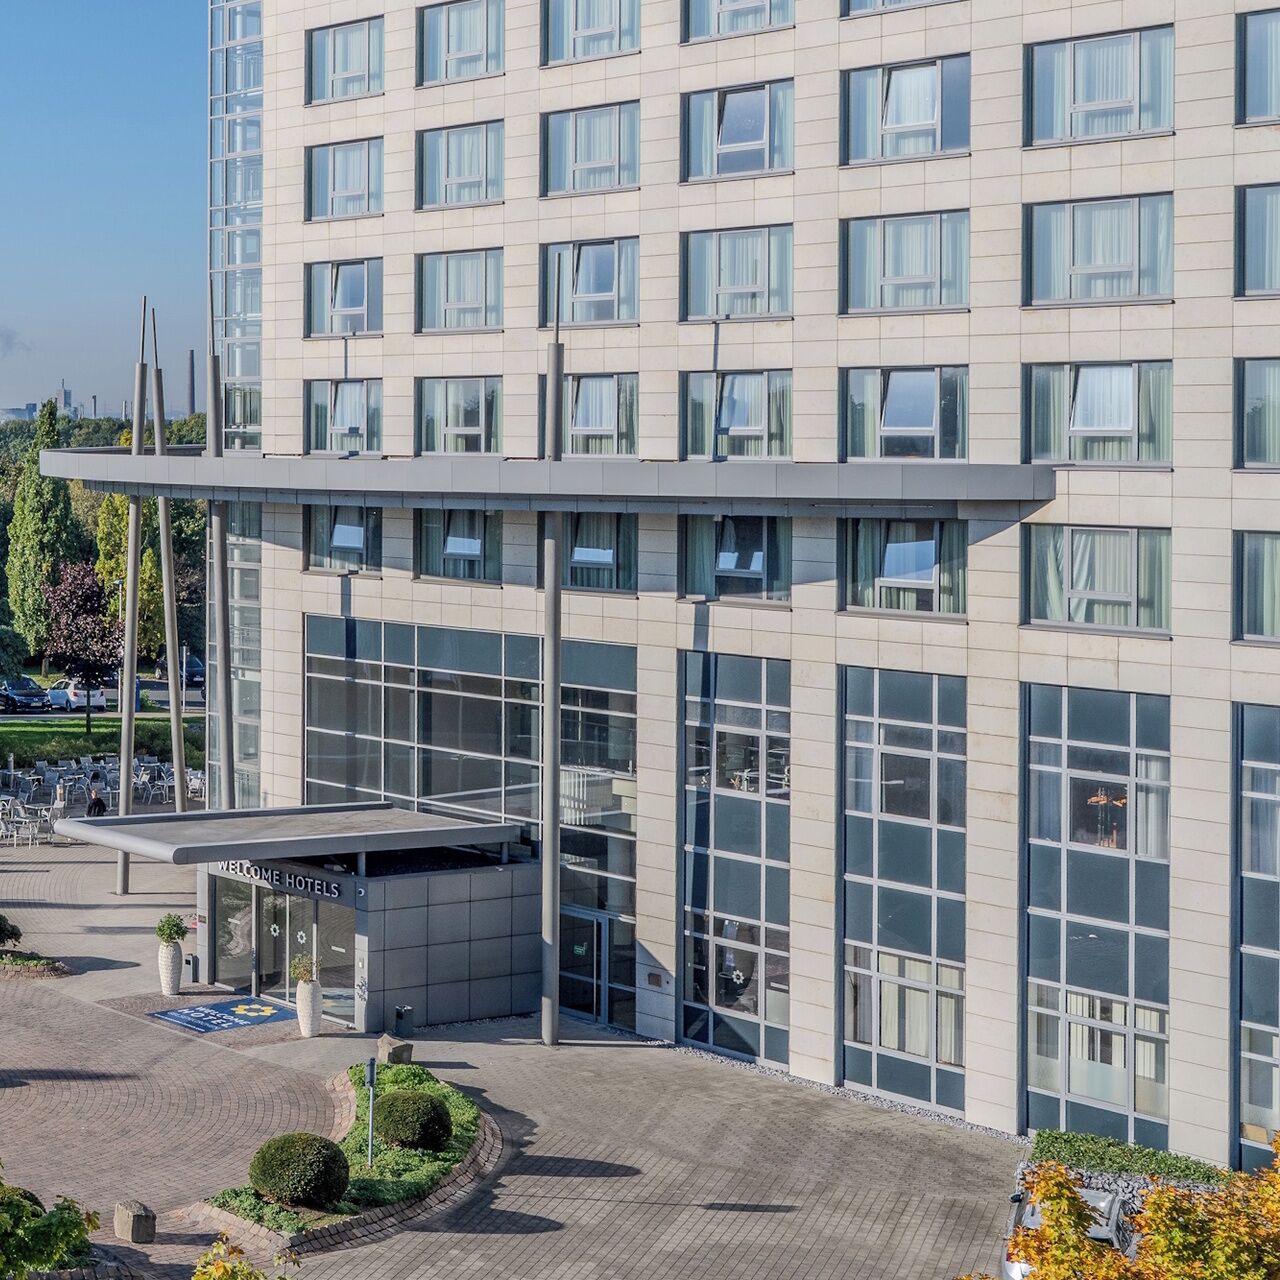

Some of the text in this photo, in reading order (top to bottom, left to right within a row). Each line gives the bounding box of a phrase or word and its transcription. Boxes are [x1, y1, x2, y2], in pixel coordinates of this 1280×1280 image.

[218, 860, 339, 898] WELCOME HOTELS
[177, 1008, 233, 1028] HOTEL
